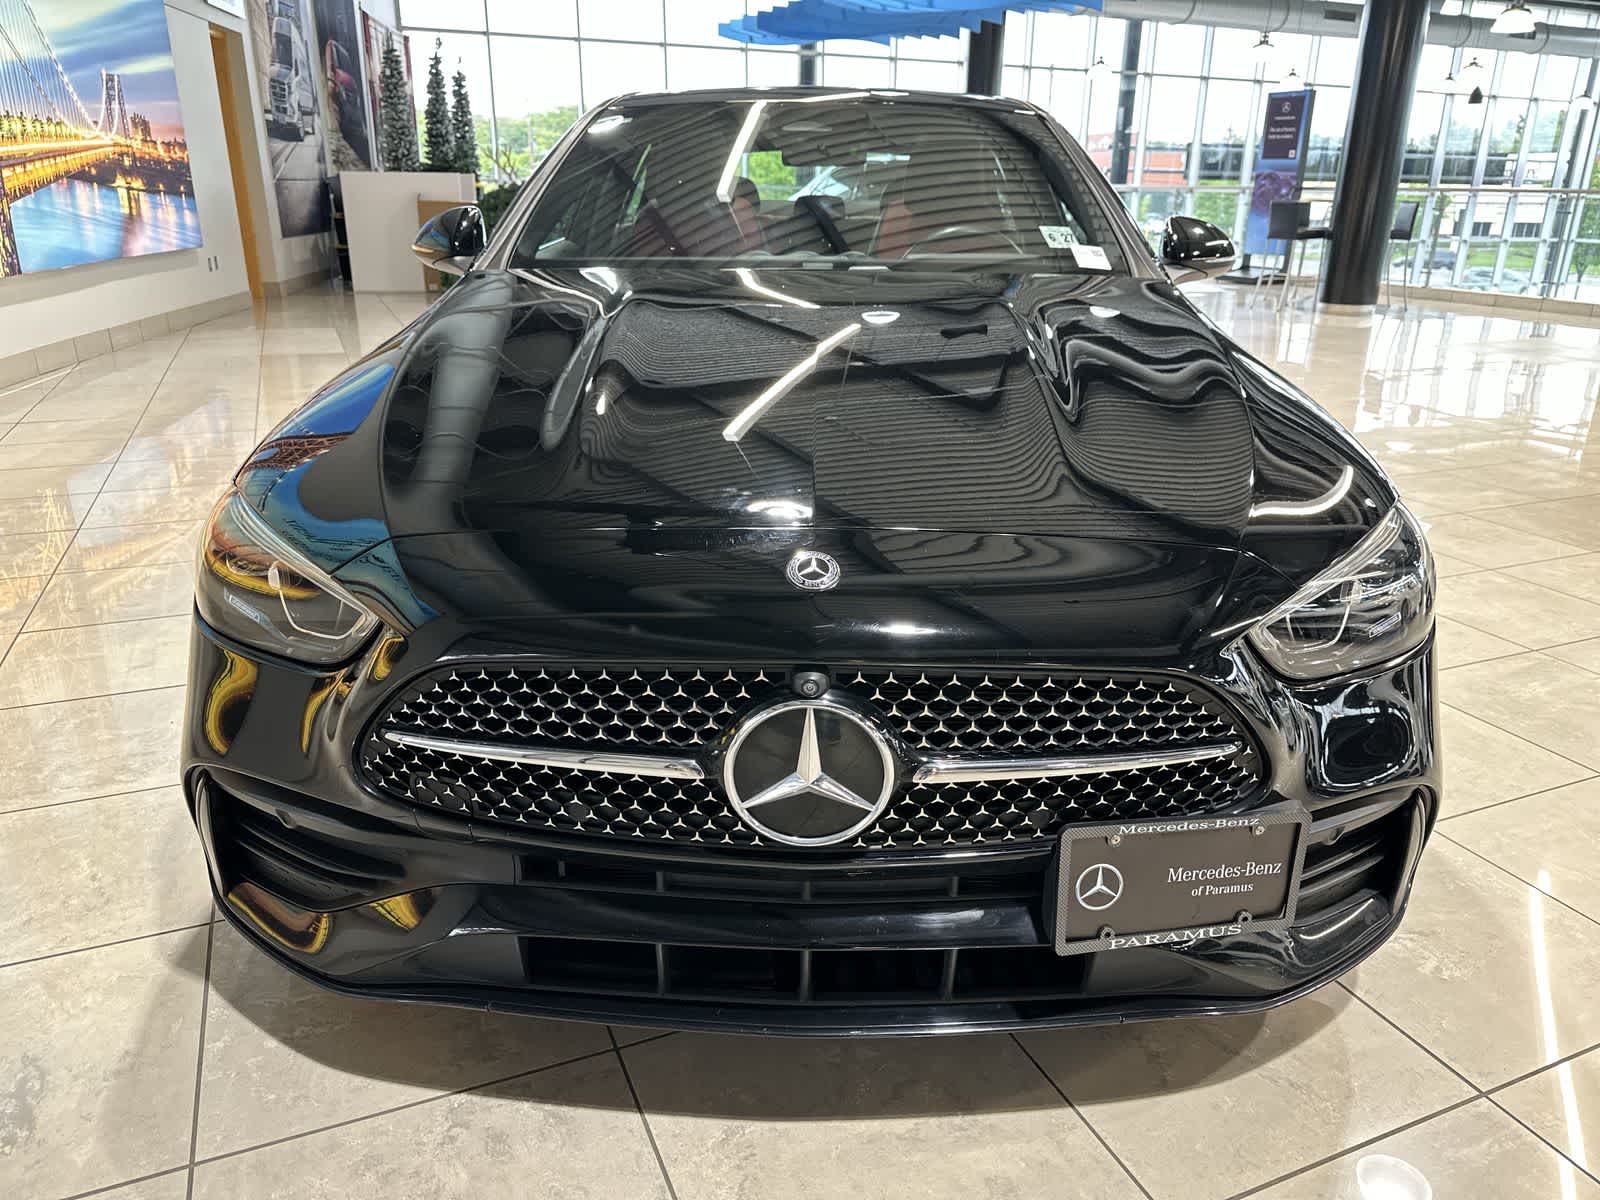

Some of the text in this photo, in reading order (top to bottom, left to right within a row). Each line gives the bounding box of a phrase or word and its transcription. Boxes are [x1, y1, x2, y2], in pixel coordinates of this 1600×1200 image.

[1060, 233, 1073, 243] 27
[1118, 818, 1260, 835] Mercedes-Benz
[1167, 861, 1282, 883] Mercedes-Benz
[1191, 883, 1254, 897] of Paramus
[1109, 924, 1242, 950] PARAMUS
